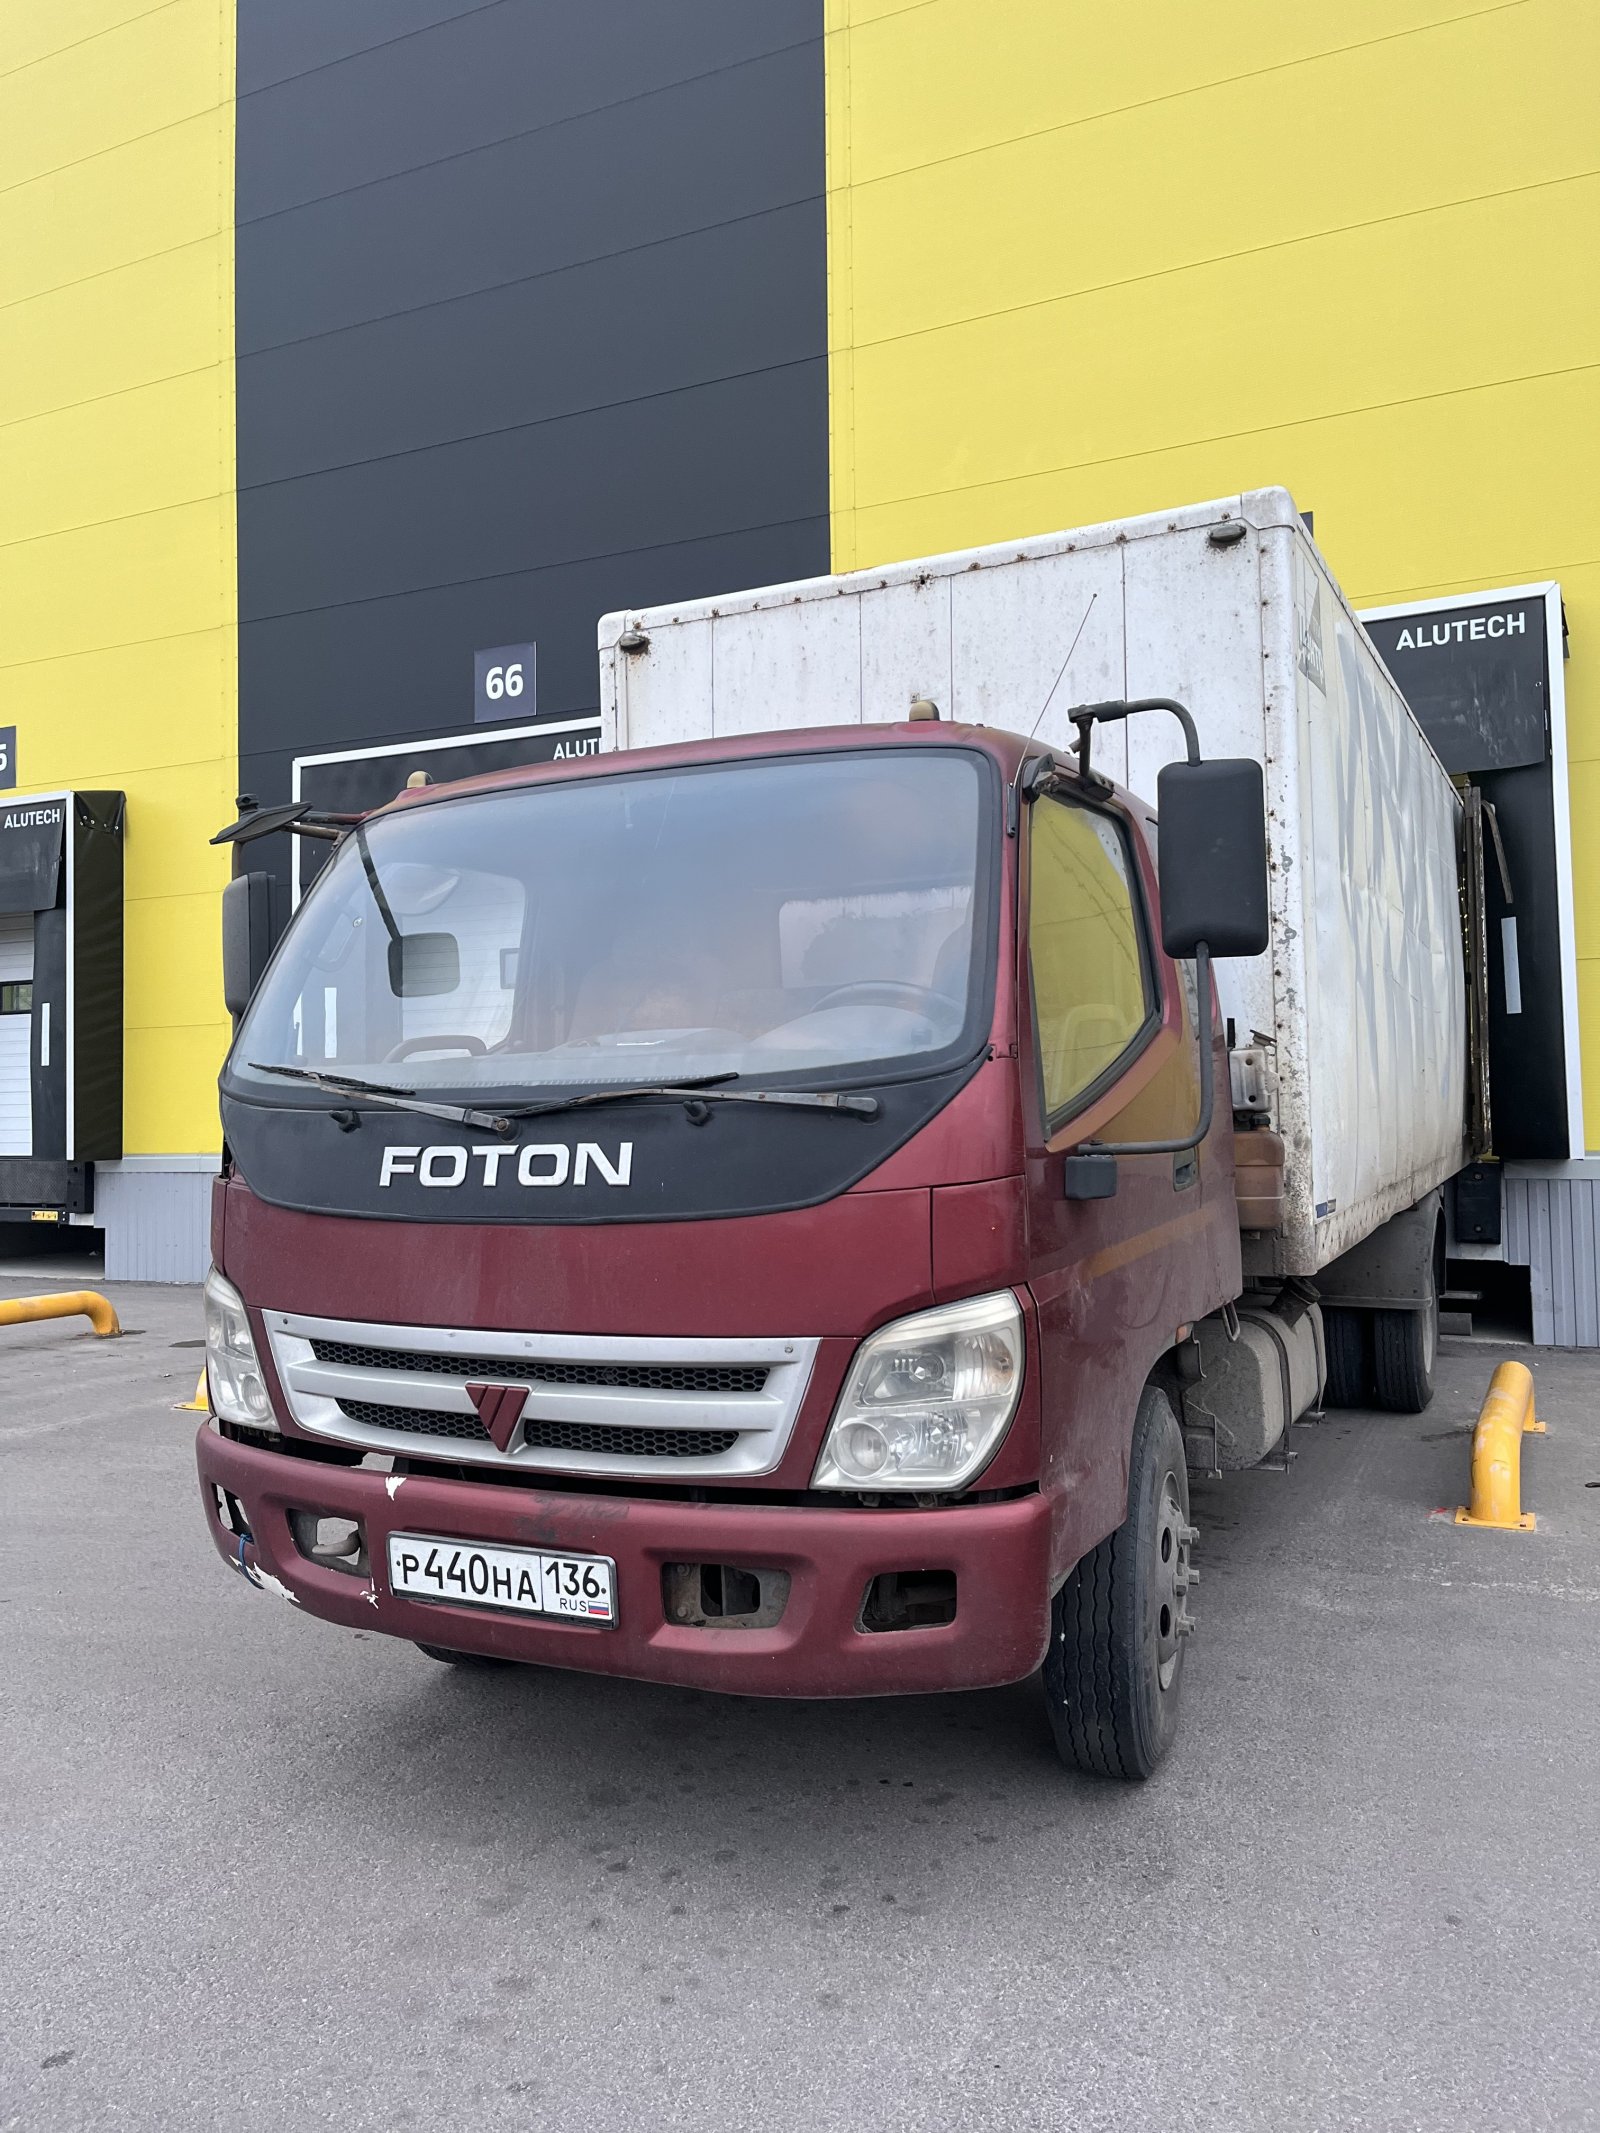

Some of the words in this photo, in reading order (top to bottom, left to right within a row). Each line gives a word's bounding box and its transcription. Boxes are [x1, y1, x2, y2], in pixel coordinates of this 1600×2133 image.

[1396, 612, 1526, 651] ALUTECH
[485, 663, 524, 700] 66
[553, 738, 601, 760] ALUT
[4, 808, 61, 829] ALUTECH
[379, 1142, 633, 1187] FOTON
[545, 1561, 600, 1598] 136
[559, 1598, 587, 1612] RUS
